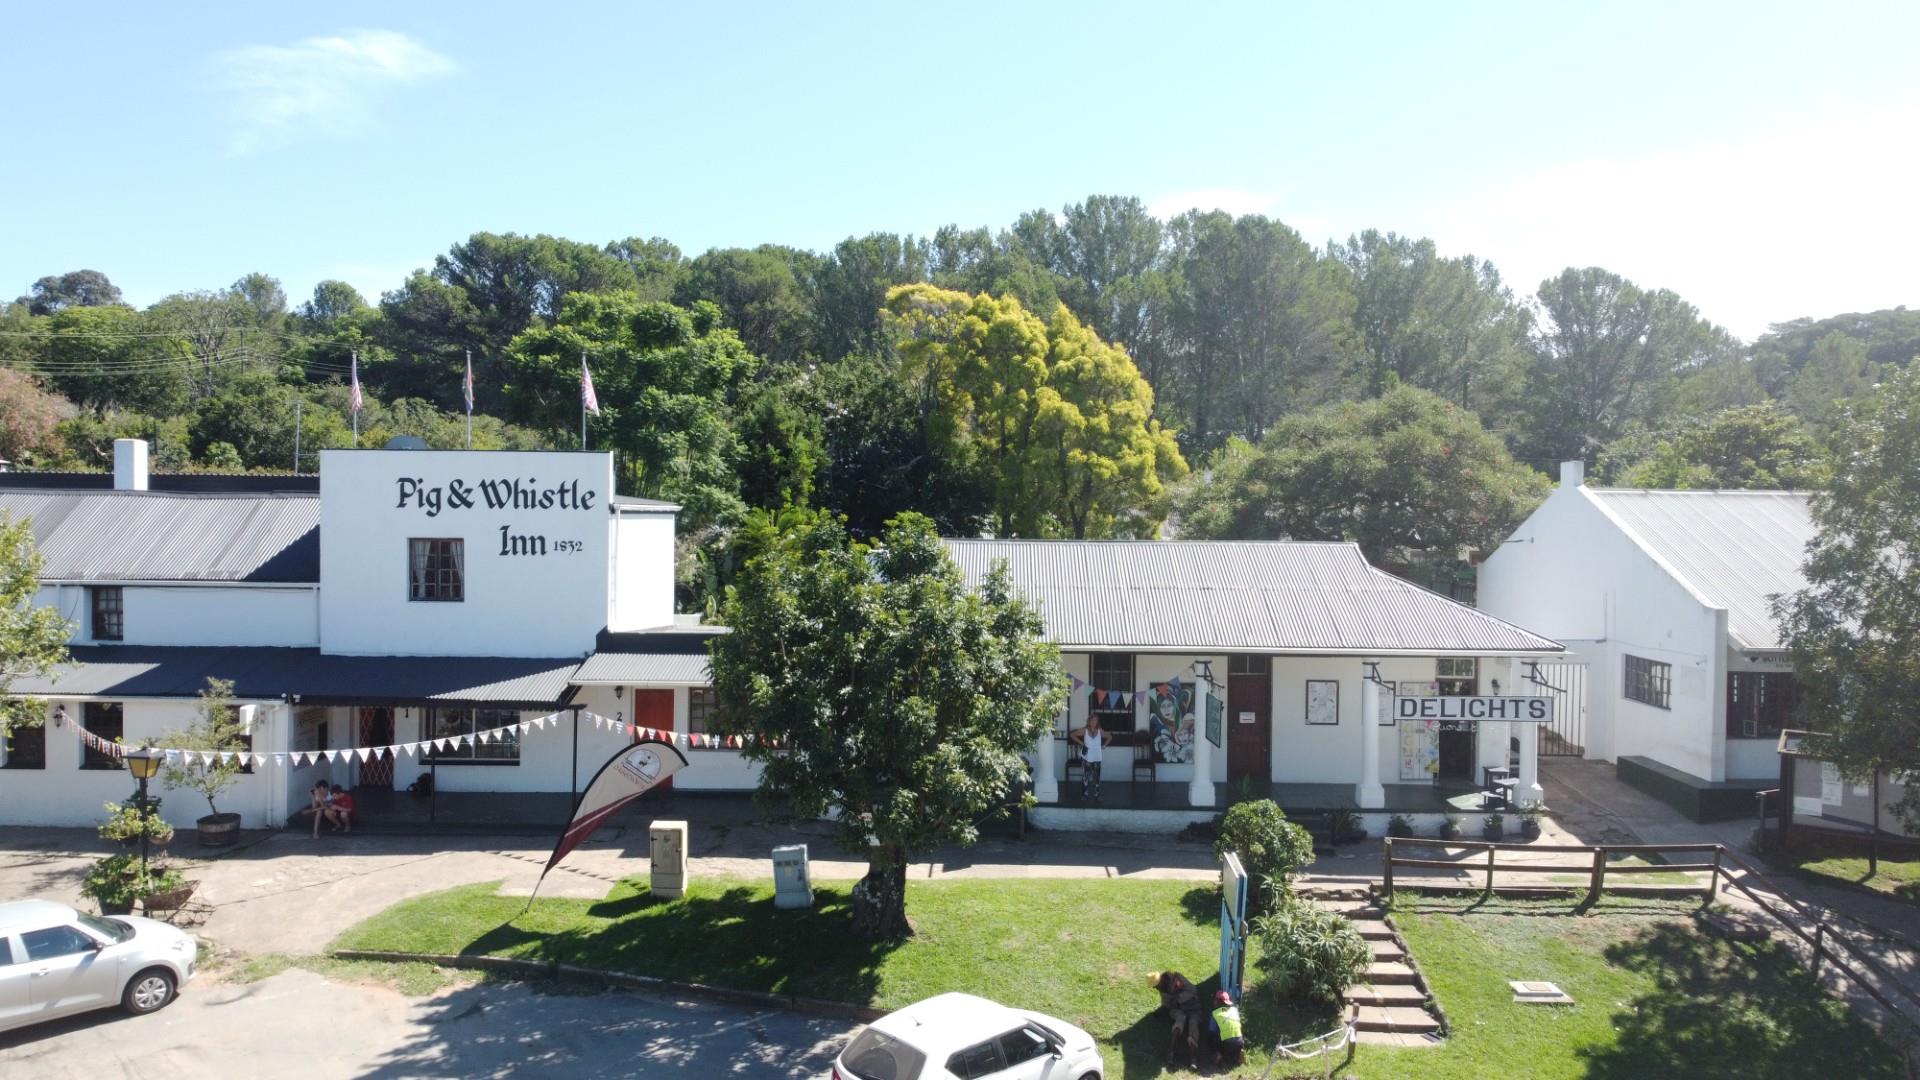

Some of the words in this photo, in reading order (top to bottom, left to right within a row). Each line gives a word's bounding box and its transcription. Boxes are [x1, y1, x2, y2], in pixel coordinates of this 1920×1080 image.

[396, 477, 442, 518] Pig
[446, 478, 475, 510] &
[478, 477, 596, 511] Whistle
[499, 525, 547, 556] Inn
[553, 540, 584, 556] 1832
[616, 711, 623, 722] 2
[1400, 698, 1547, 719] DELIGHTS
